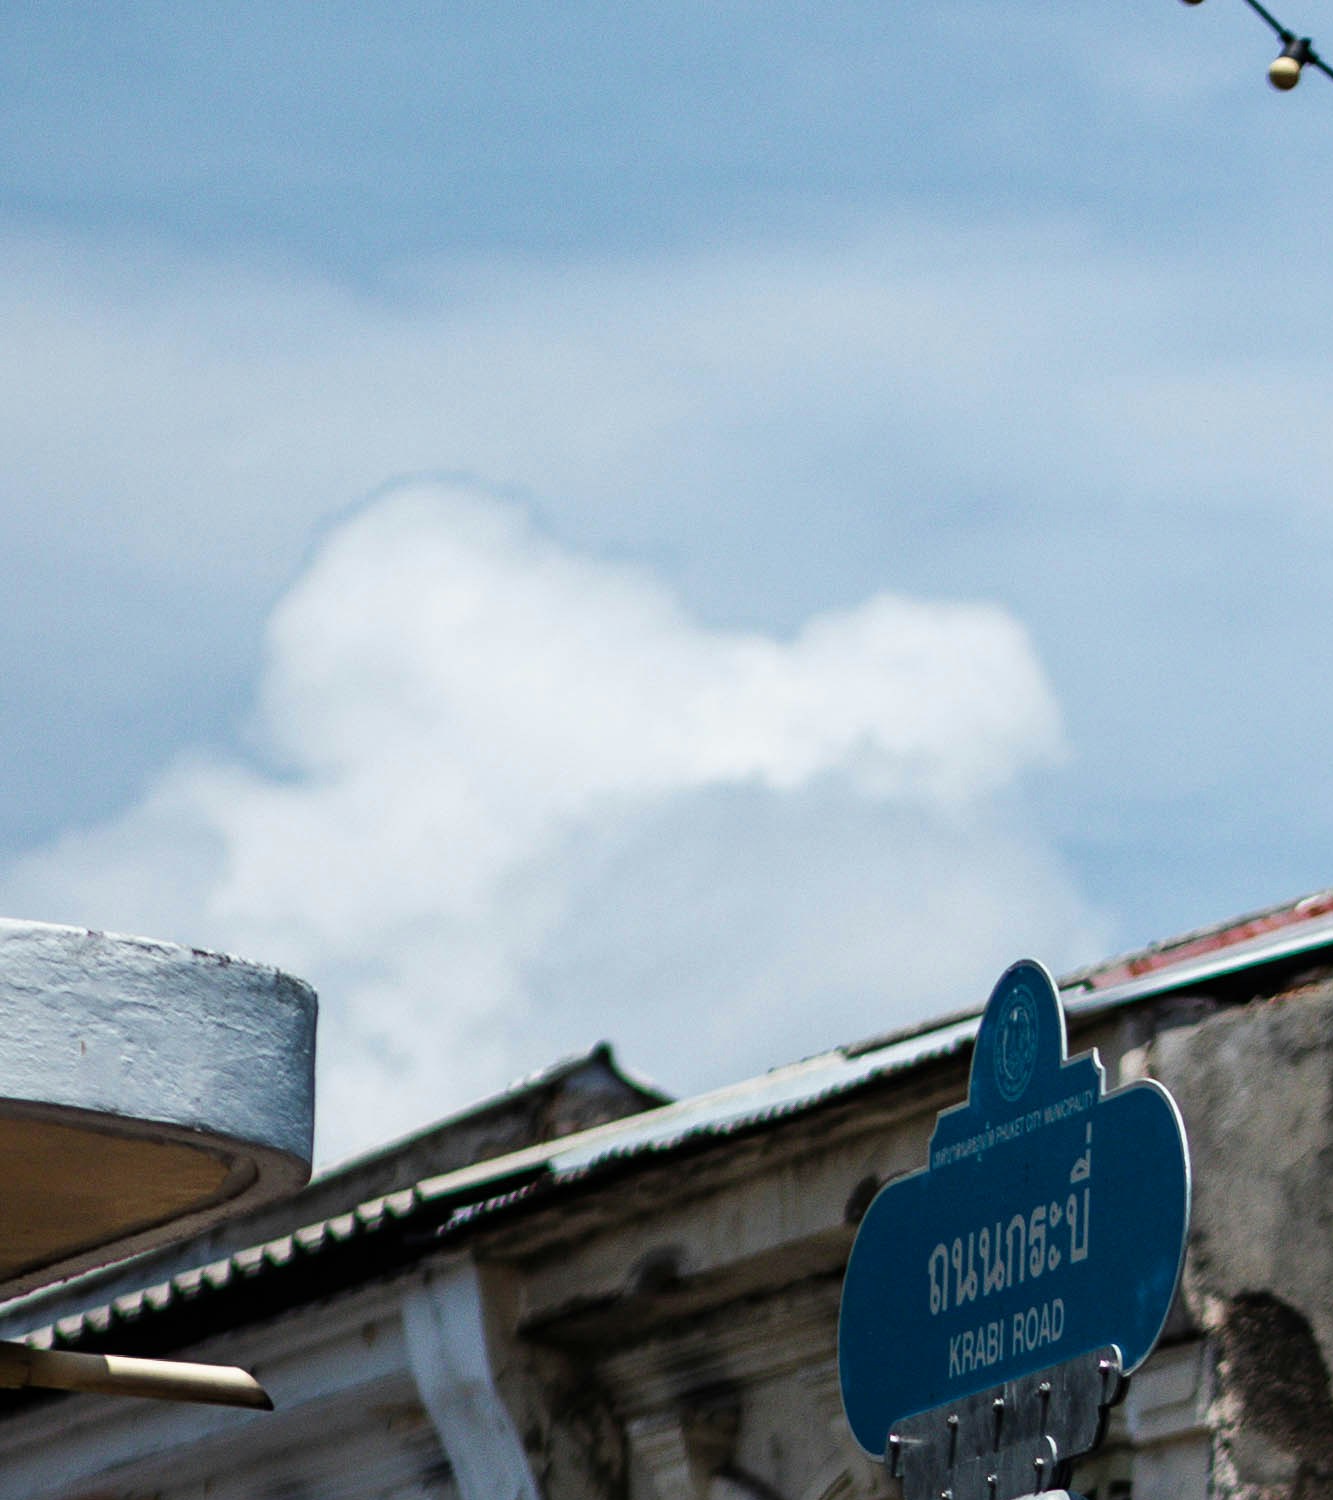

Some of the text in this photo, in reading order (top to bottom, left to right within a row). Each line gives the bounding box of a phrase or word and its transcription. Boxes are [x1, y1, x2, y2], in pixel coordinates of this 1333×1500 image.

[928, 1121, 1092, 1316] ถนนกระบี่
[948, 1298, 1065, 1379] KRABI ROAD
